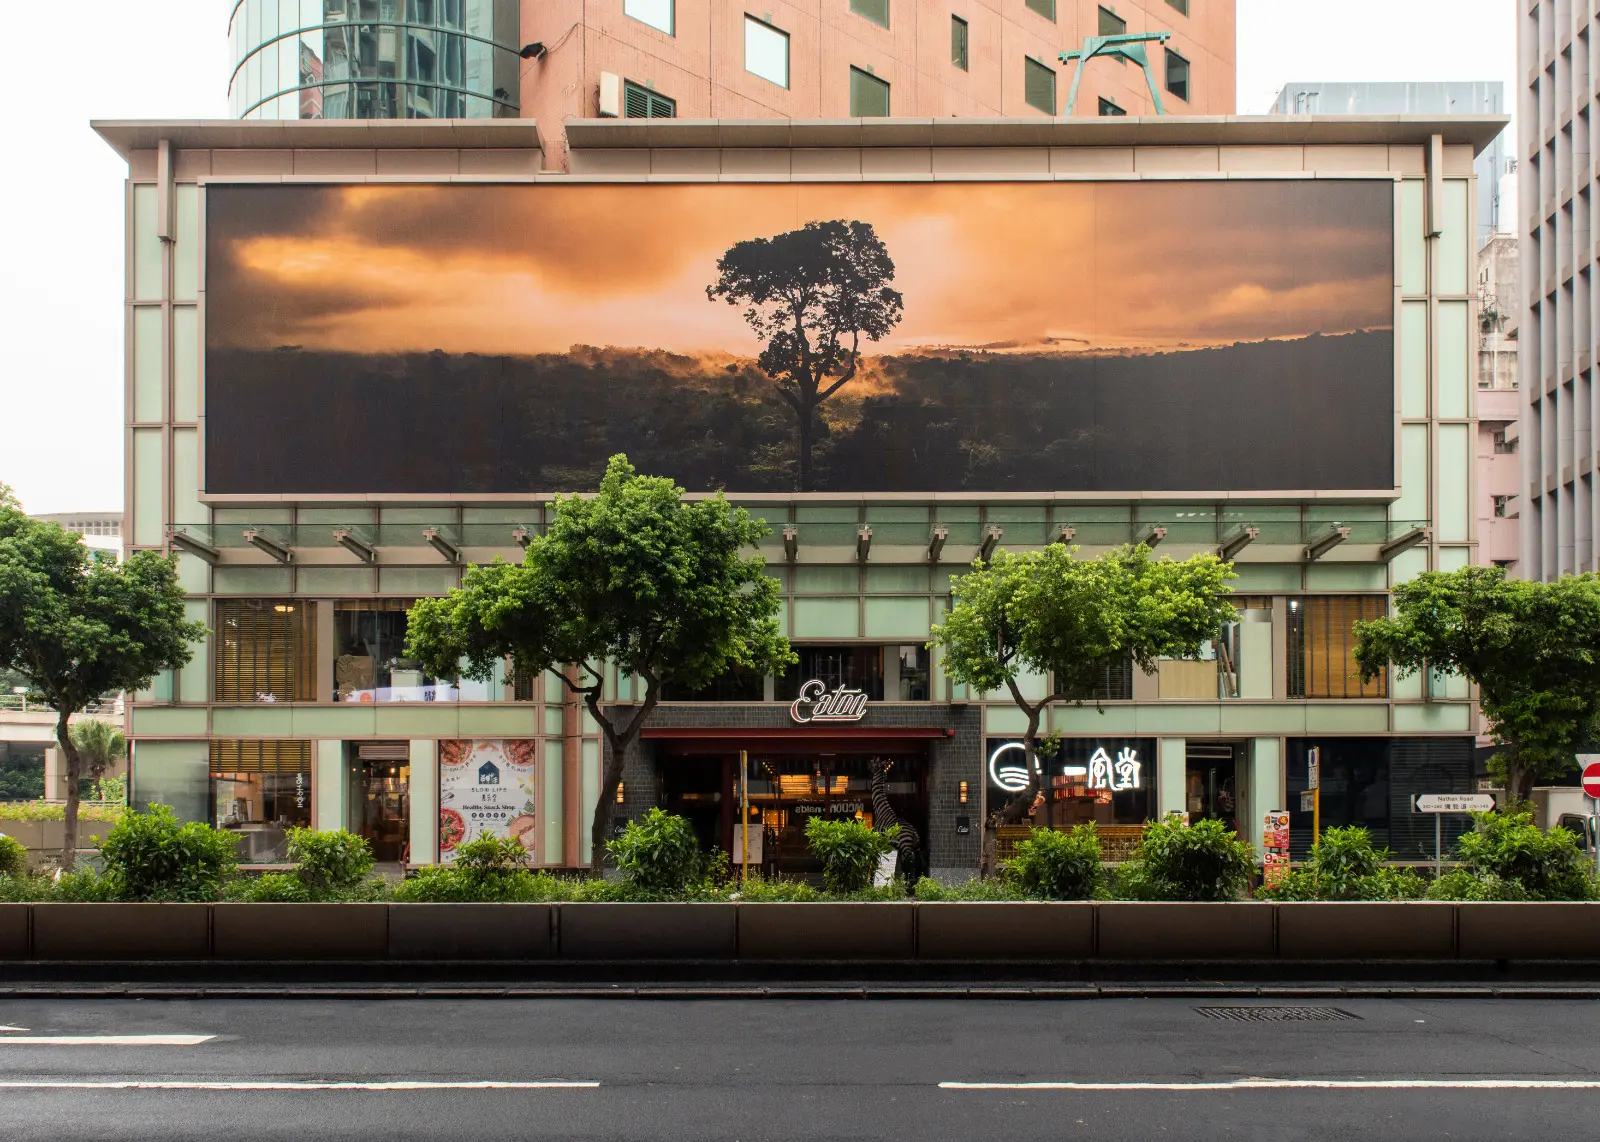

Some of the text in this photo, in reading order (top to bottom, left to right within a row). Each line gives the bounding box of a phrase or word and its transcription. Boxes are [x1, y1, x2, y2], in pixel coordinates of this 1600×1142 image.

[790, 679, 869, 723] Eaton
[1063, 746, 1141, 791] 一風堂
